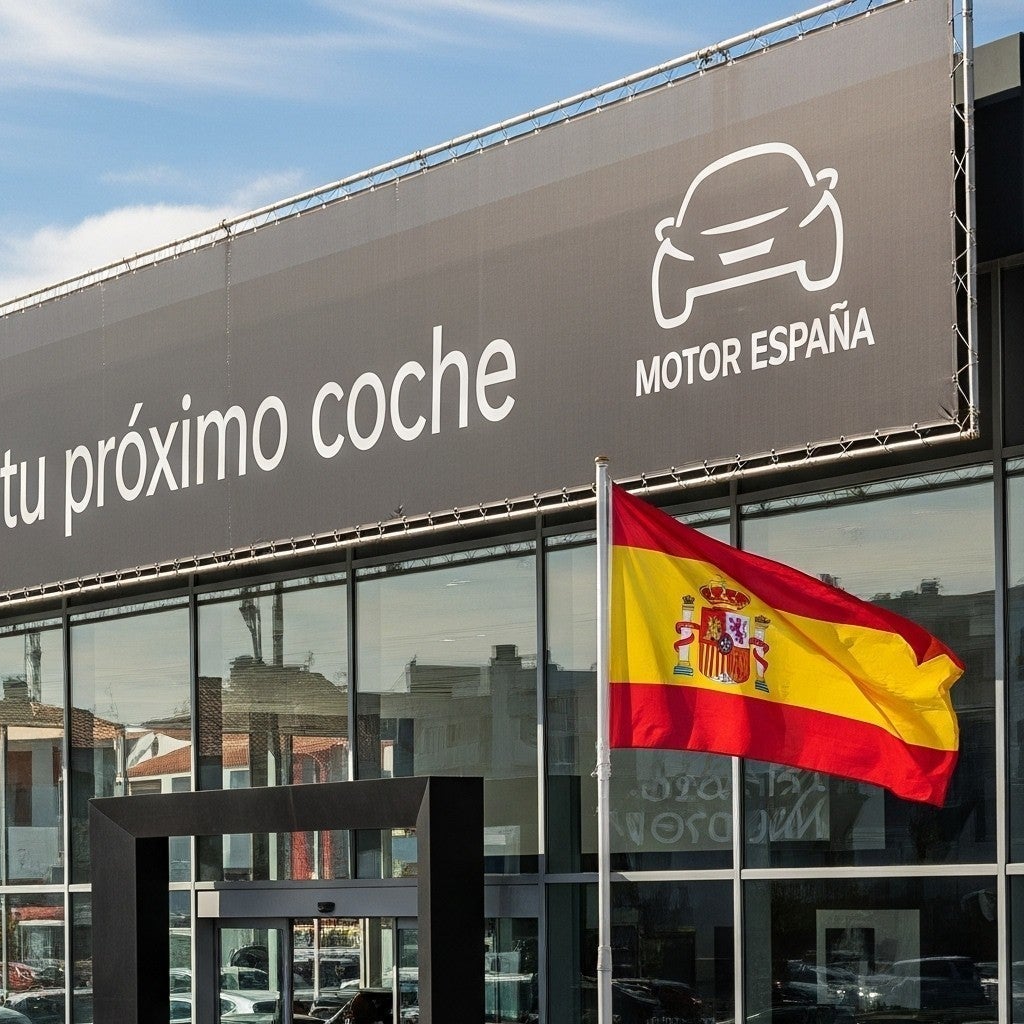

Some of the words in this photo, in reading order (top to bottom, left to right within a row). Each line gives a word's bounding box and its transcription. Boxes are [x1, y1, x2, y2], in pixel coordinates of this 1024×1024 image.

[636, 338, 741, 397] MOTOR
[751, 300, 875, 371] ESPAÑA
[0, 449, 46, 529] tu
[65, 394, 288, 538] próximo
[311, 325, 517, 459] coche
